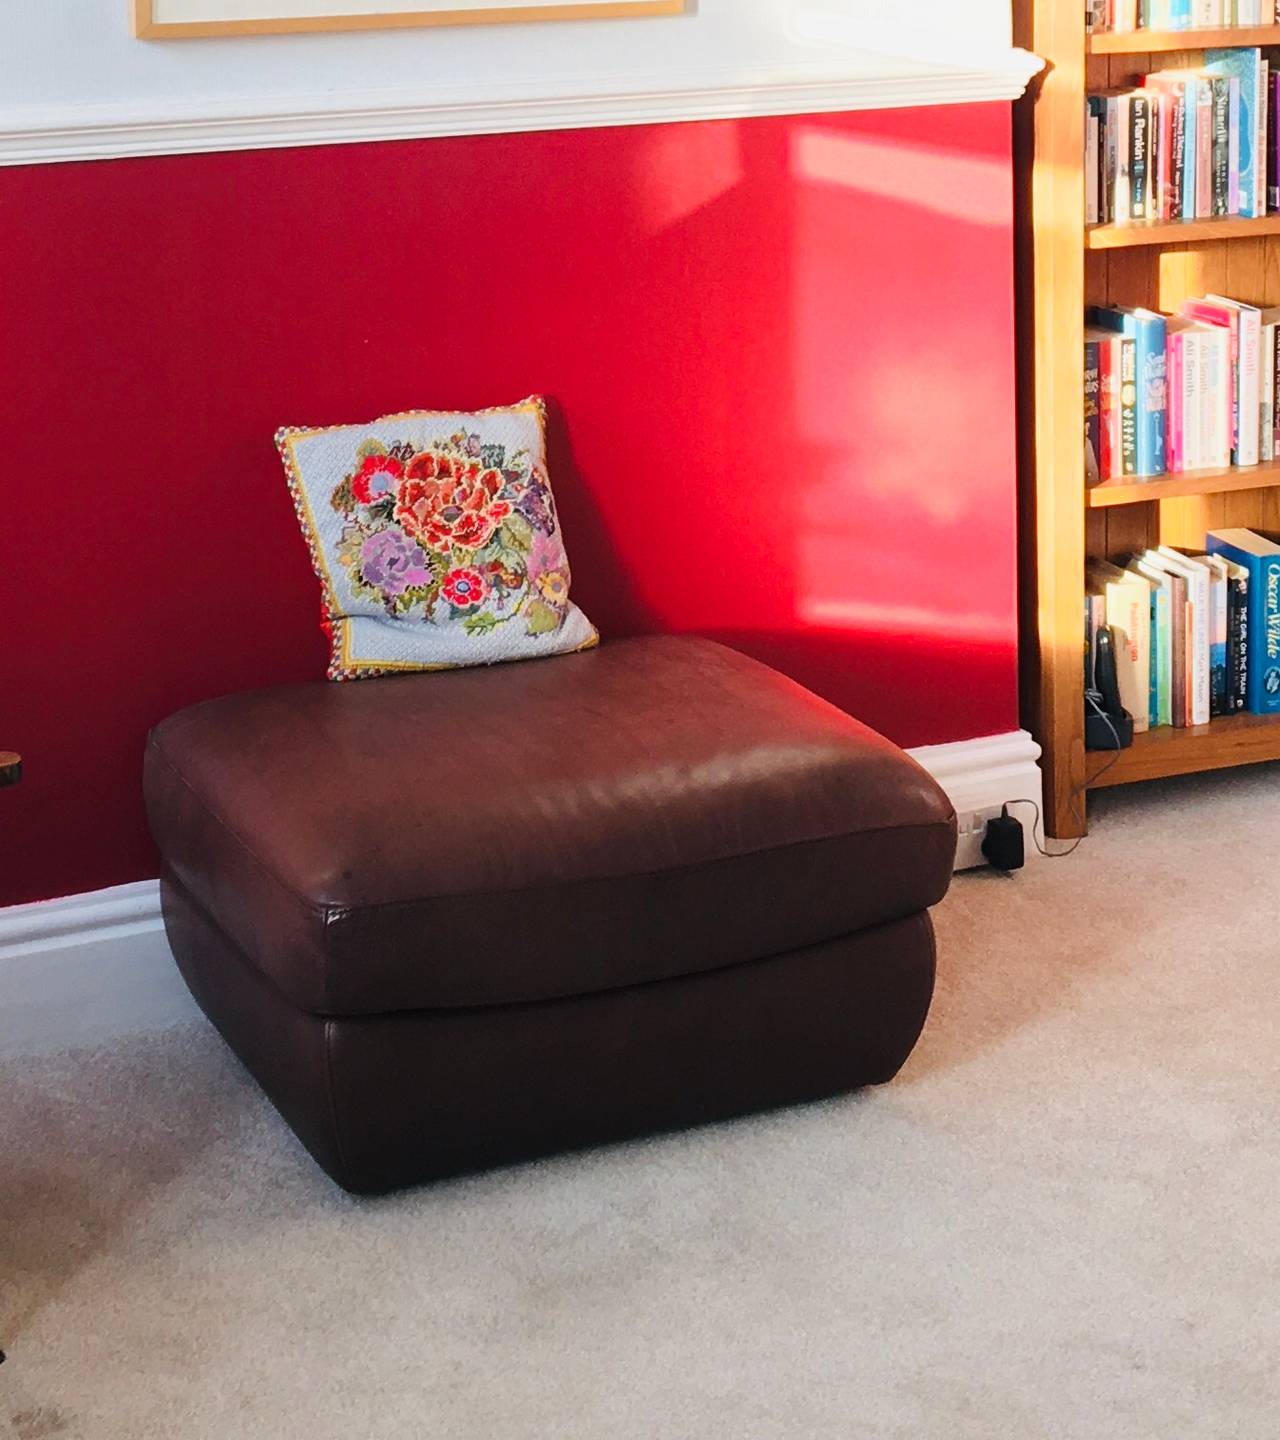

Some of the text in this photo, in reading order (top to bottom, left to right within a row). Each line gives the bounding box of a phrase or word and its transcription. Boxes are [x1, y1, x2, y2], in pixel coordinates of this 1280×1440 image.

[1134, 99, 1146, 161] Ian Rankin
[1185, 340, 1195, 398] Ali Smith
[1199, 345, 1209, 395] Ali Smith
[1246, 319, 1258, 377] Ali Smith
[1240, 606, 1248, 695] THE GIRL ON THE TRAIN
